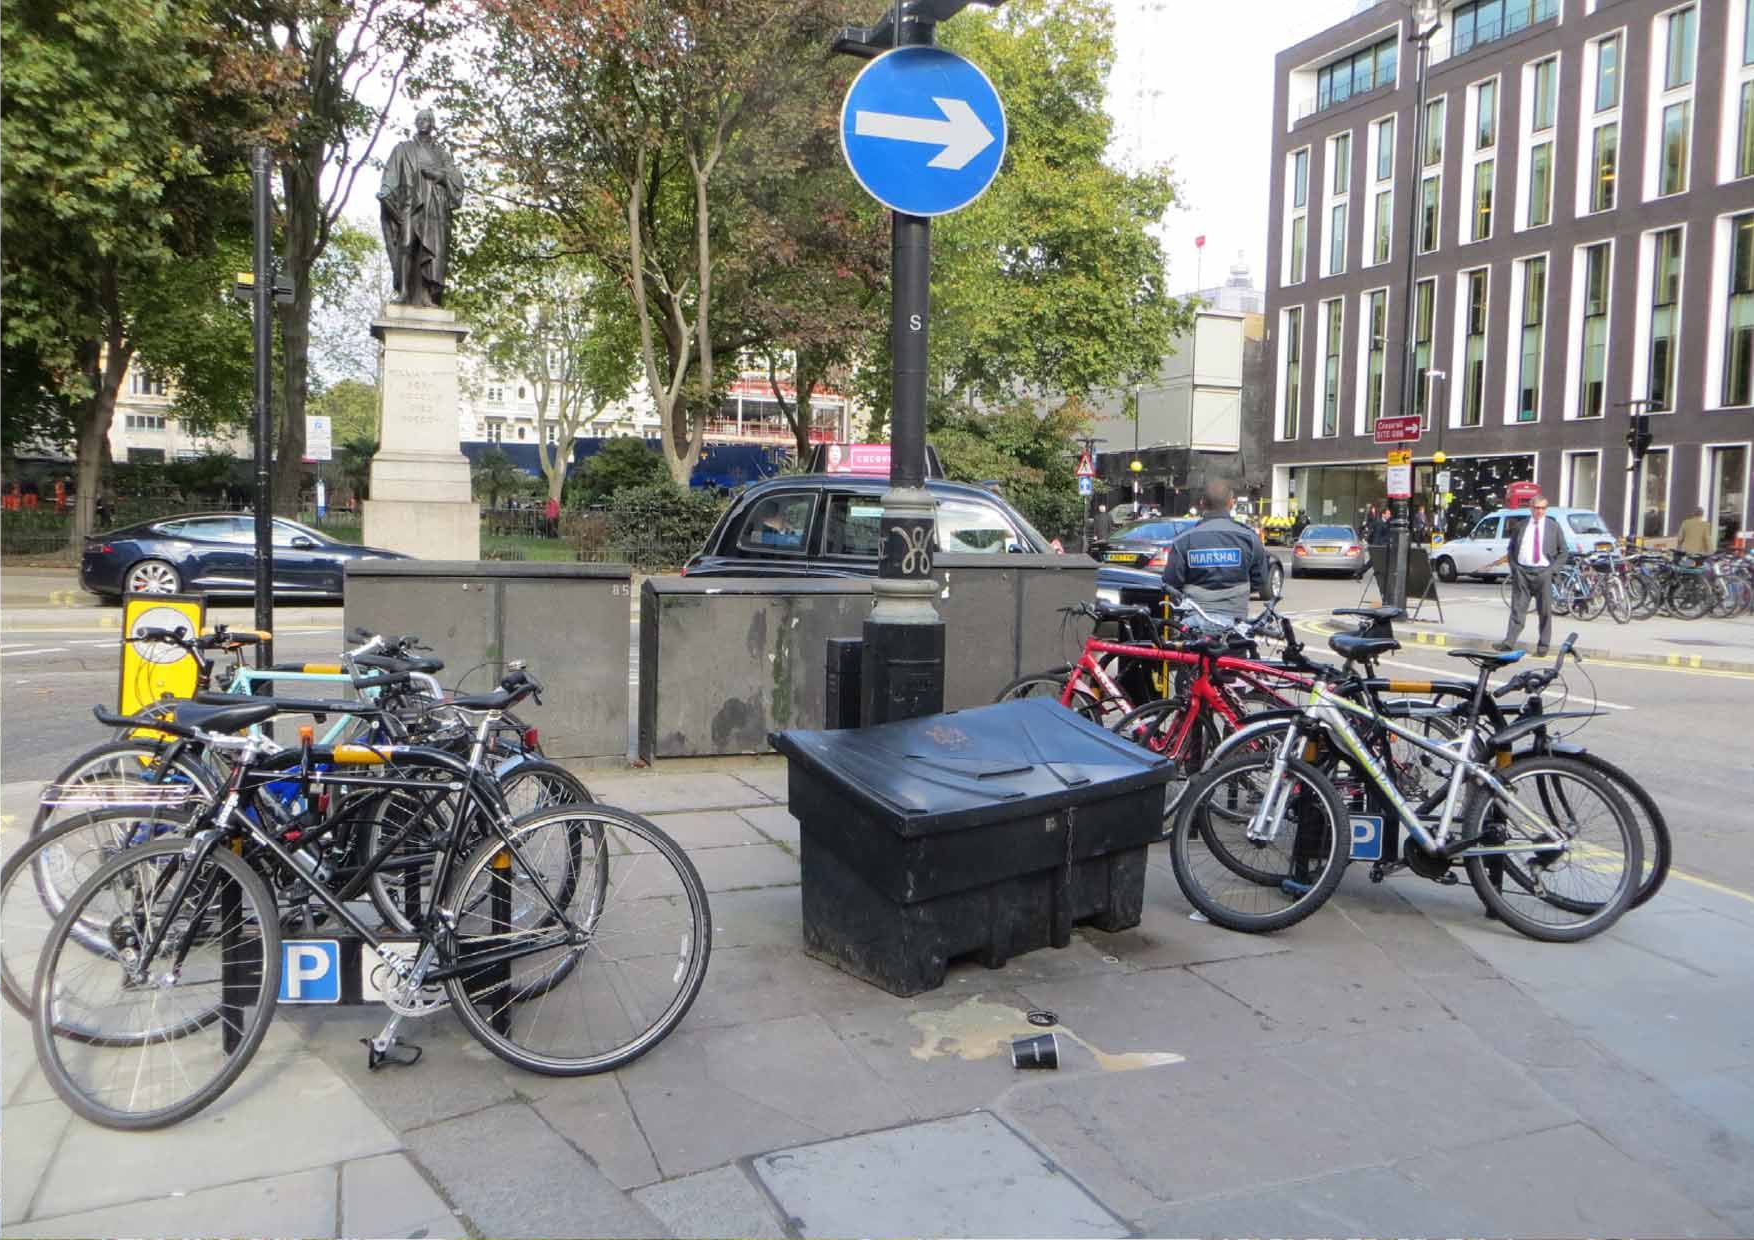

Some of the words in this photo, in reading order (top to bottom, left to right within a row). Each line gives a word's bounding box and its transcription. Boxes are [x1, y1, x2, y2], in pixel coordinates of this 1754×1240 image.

[909, 314, 922, 331] S
[1190, 550, 1238, 564] MARSHAL
[1349, 819, 1376, 856] P
[287, 945, 330, 998] P
